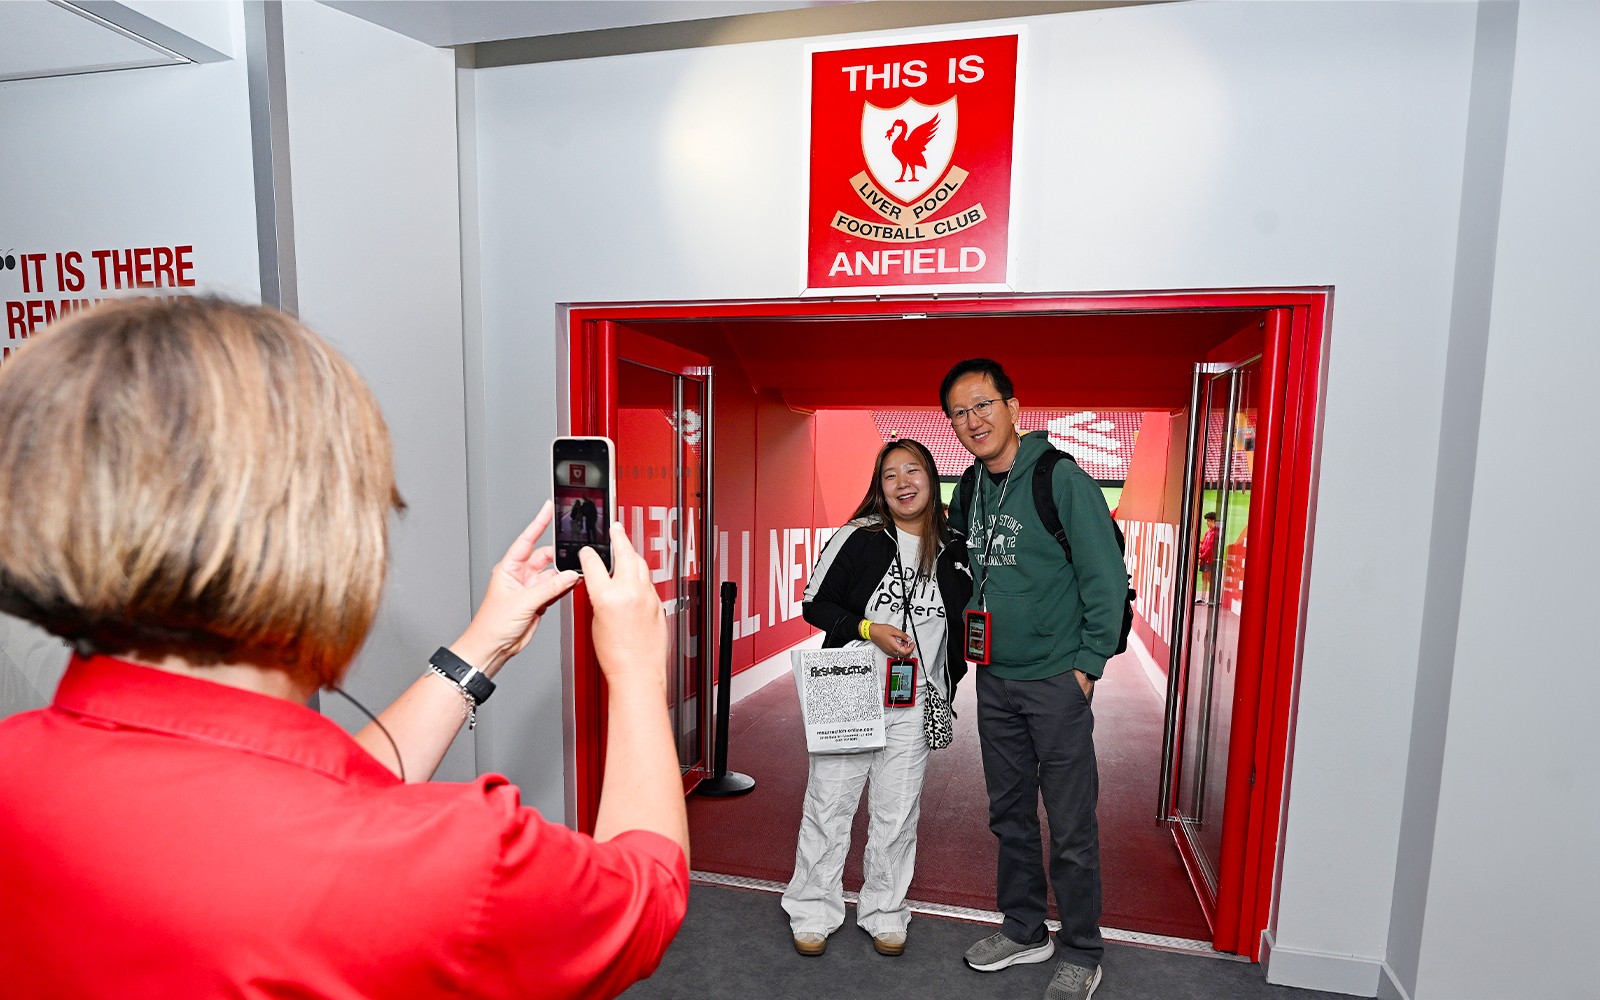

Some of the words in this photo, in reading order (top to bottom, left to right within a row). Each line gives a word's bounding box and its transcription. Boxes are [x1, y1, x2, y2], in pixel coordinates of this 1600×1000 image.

[842, 60, 928, 92] THIS
[948, 54, 985, 84] IS
[858, 182, 902, 220] LIVER
[913, 181, 959, 219] POOL
[837, 215, 925, 240] FOOTBALL
[933, 209, 981, 235] CLUB
[56, 251, 85, 292] IS
[91, 245, 196, 291] THERE
[828, 246, 987, 277] ANFIELD
[768, 527, 841, 628] NEV
